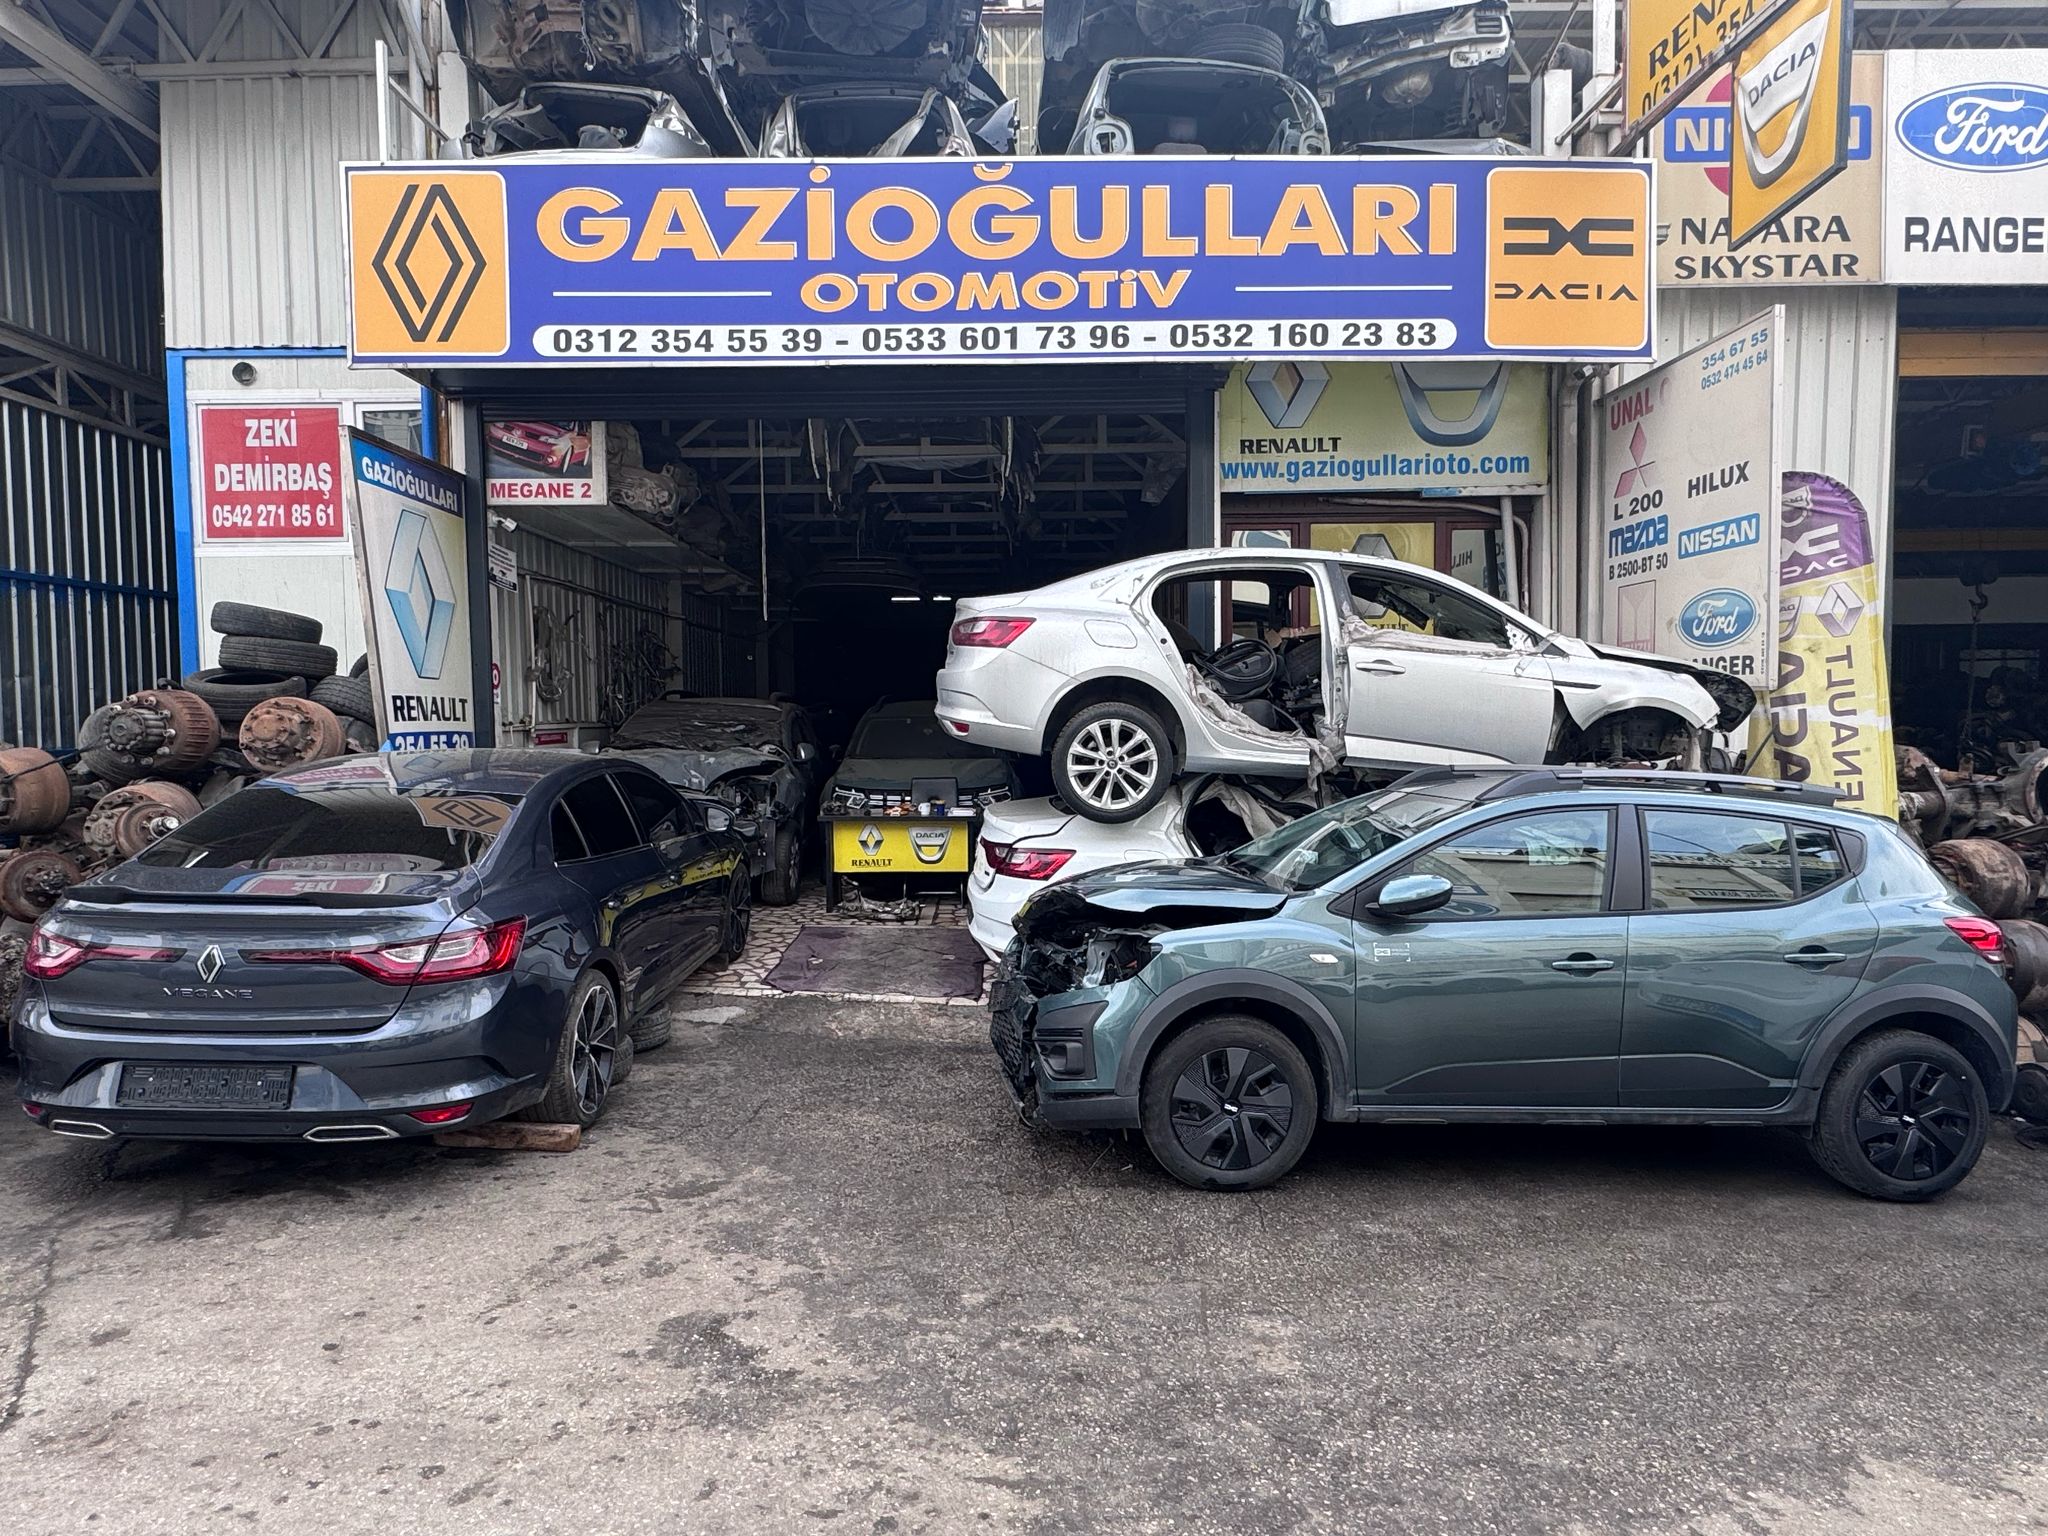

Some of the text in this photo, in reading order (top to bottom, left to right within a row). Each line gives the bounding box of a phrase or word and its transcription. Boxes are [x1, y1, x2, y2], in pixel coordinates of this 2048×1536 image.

[1748, 41, 1816, 108] DACIA
[1934, 96, 2048, 156] Ford
[537, 162, 1457, 262] GAZİOĞULLARI
[1681, 215, 1851, 244] NAARA
[1904, 216, 2048, 253] RANGE
[1674, 254, 1859, 280] SKYSTAR
[1495, 283, 1638, 301] DACIA
[553, 328, 637, 353] 0312
[651, 328, 714, 353] 354
[727, 328, 768, 353] 55
[781, 328, 822, 352] 39
[862, 327, 946, 351] 0533
[960, 326, 1018, 351] 601
[1035, 325, 1076, 350] 73
[1089, 325, 1130, 349] 96
[1170, 323, 1253, 348] 0532
[1268, 323, 1329, 347] 160
[1342, 323, 1383, 346] 23
[1396, 322, 1437, 346] 83
[1702, 328, 1768, 370] 354 67 55
[1701, 350, 1768, 390] 0532 474 45 64
[1610, 387, 1654, 431] ÜNAL
[245, 410, 297, 447] ZEKİ
[1240, 437, 1341, 454] RENAULT
[214, 455, 333, 500] DEMİRBAŞ
[1221, 453, 1530, 483] www.gaziogullarioto.com
[1688, 461, 1749, 499] HILUX
[361, 456, 458, 513] GAZİOĞULLARI
[491, 483, 592, 498] MEGANE 2
[212, 503, 334, 528] 0542 271 85 61
[1614, 489, 1663, 521] L 200
[1681, 517, 1756, 555] NISSAN
[1609, 552, 1668, 580] B 2500-BT 50
[1693, 599, 1738, 637] Ford
[391, 695, 467, 722] RENAULT
[915, 831, 945, 839] DACIA
[851, 858, 892, 867] RENAULT
[163, 987, 253, 999] MEGANE
